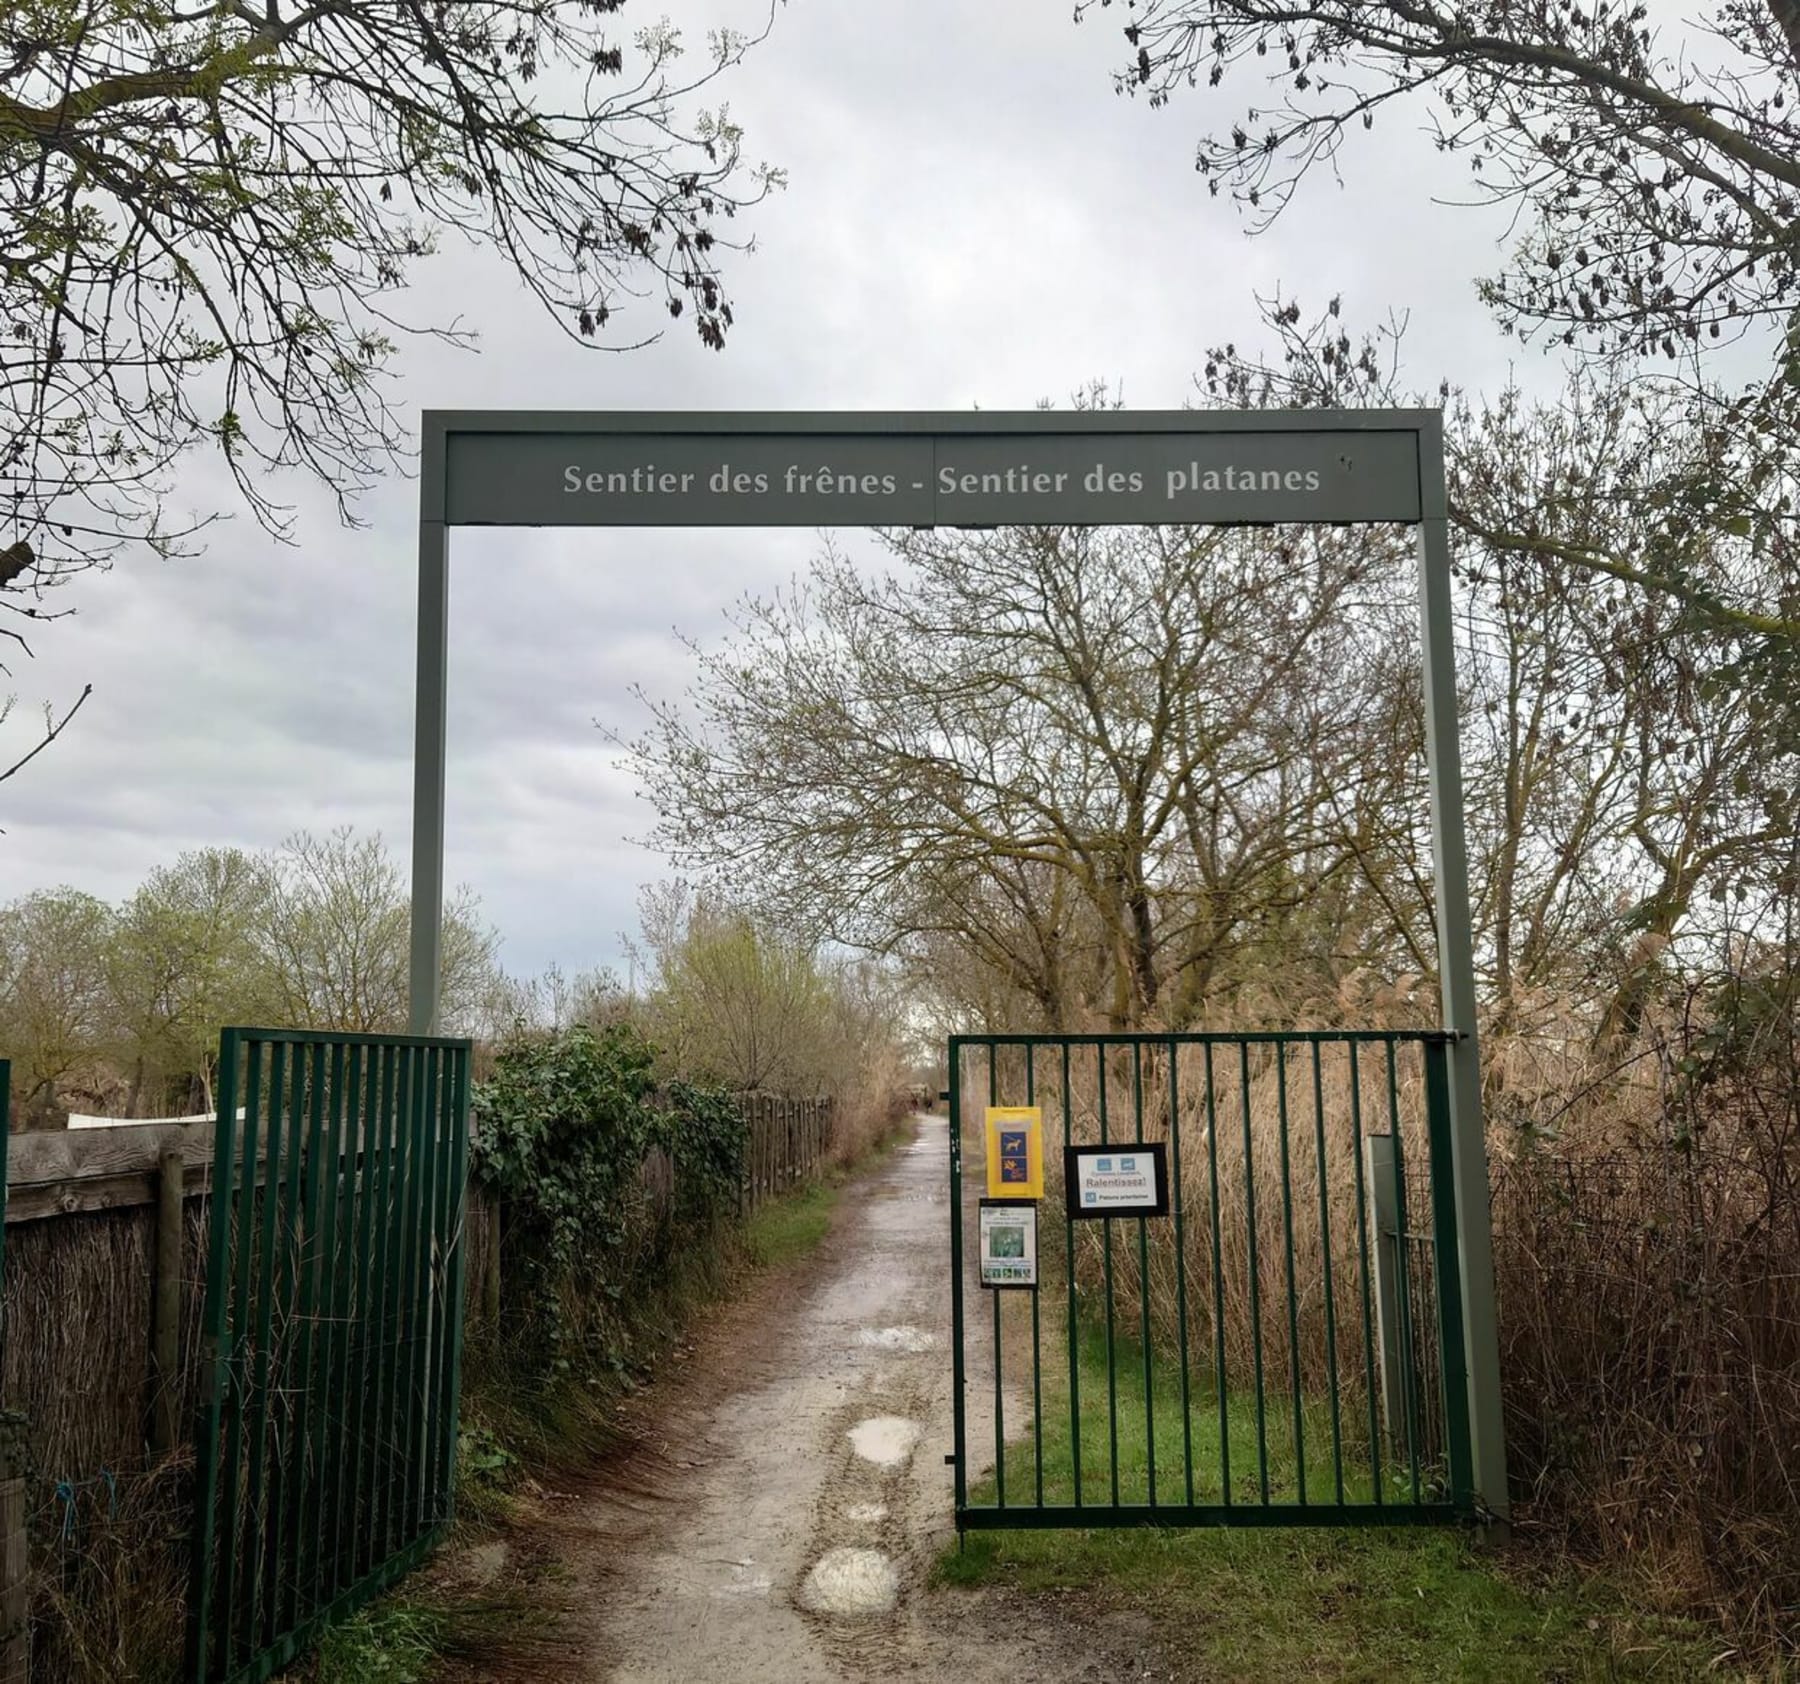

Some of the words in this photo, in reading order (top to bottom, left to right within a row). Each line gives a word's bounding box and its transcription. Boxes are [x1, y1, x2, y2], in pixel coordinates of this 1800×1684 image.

[564, 465, 694, 493] Sentier
[709, 464, 768, 493] des
[784, 465, 896, 494] frênes
[938, 466, 1068, 494] Sentier
[1083, 464, 1144, 492] des
[1166, 462, 1320, 499] platanes
